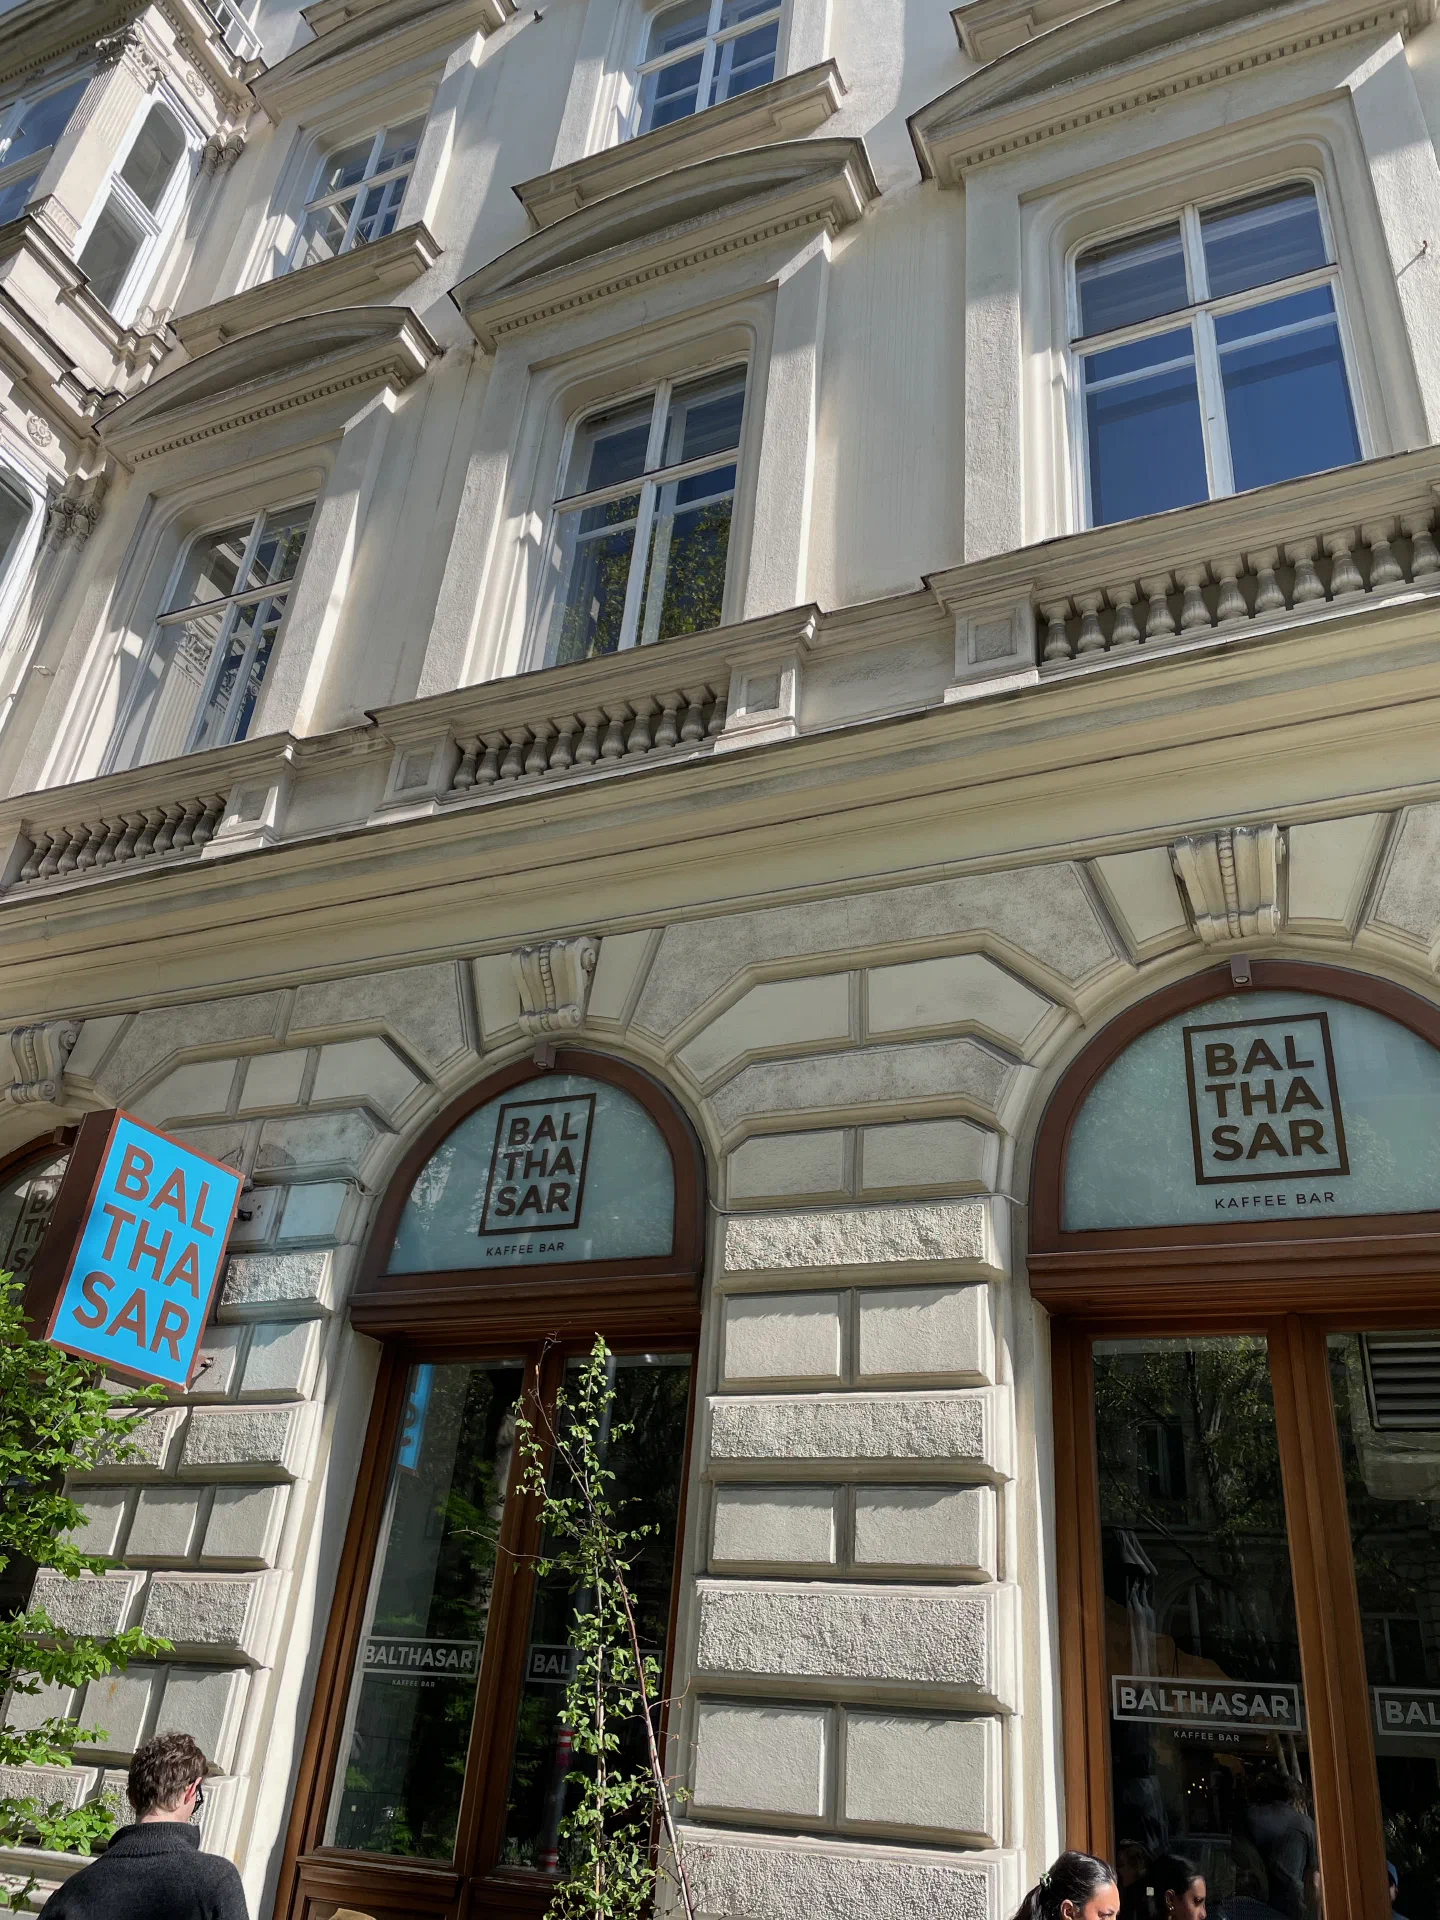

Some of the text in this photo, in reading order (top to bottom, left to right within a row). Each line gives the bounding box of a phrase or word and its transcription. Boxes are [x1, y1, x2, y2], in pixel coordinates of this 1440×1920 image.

[1204, 1035, 1315, 1077] BAL
[1204, 1075, 1325, 1118] THA
[508, 1112, 579, 1146] BAL
[1211, 1118, 1329, 1161] SAR
[503, 1146, 575, 1180] THA
[114, 1143, 215, 1238] BAL
[495, 1182, 571, 1217] SAR
[1214, 1191, 1336, 1210] KAFFEE BAR
[102, 1202, 199, 1300] THA
[486, 1242, 565, 1257] KAFFEE BAR
[72, 1270, 190, 1362] SAR
[363, 1645, 473, 1669] BALTHASAR
[391, 1679, 436, 1688] KAFFEE BAR
[1120, 1686, 1291, 1719] BALTHASAR
[1173, 1729, 1240, 1743] KAFFEE BAR
